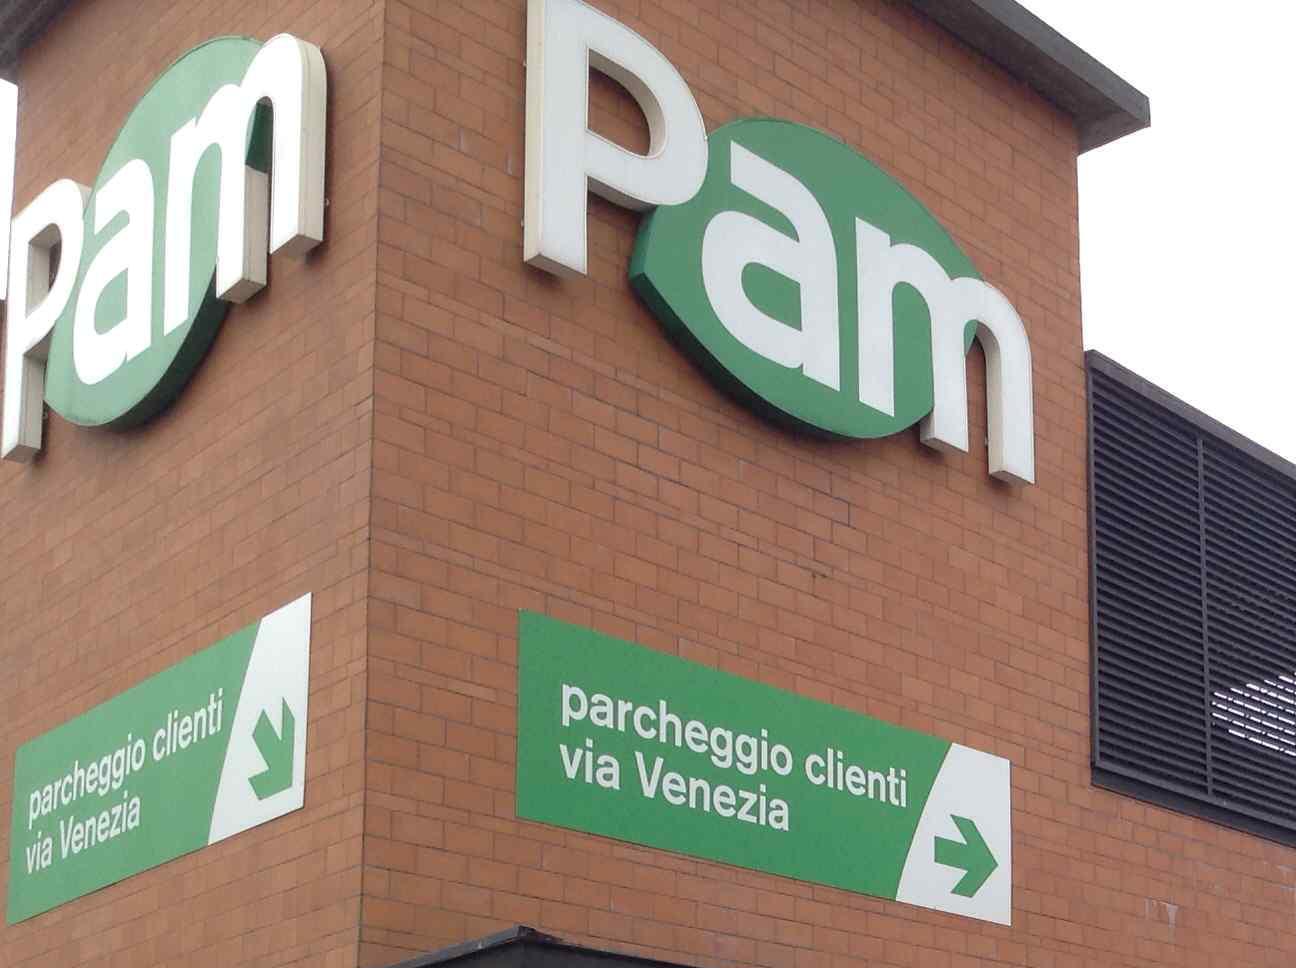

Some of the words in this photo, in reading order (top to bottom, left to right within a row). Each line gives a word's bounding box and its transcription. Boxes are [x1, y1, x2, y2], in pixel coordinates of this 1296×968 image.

[524, 0, 1034, 485] Pam
[28, 733, 147, 829] parcheggio
[152, 688, 224, 761] clienti
[559, 738, 620, 790] via
[634, 750, 790, 831] Venezia
[561, 682, 793, 776] parcheggio
[804, 747, 907, 808] clienti
[25, 831, 52, 874] via
[59, 792, 141, 859] Venezia
